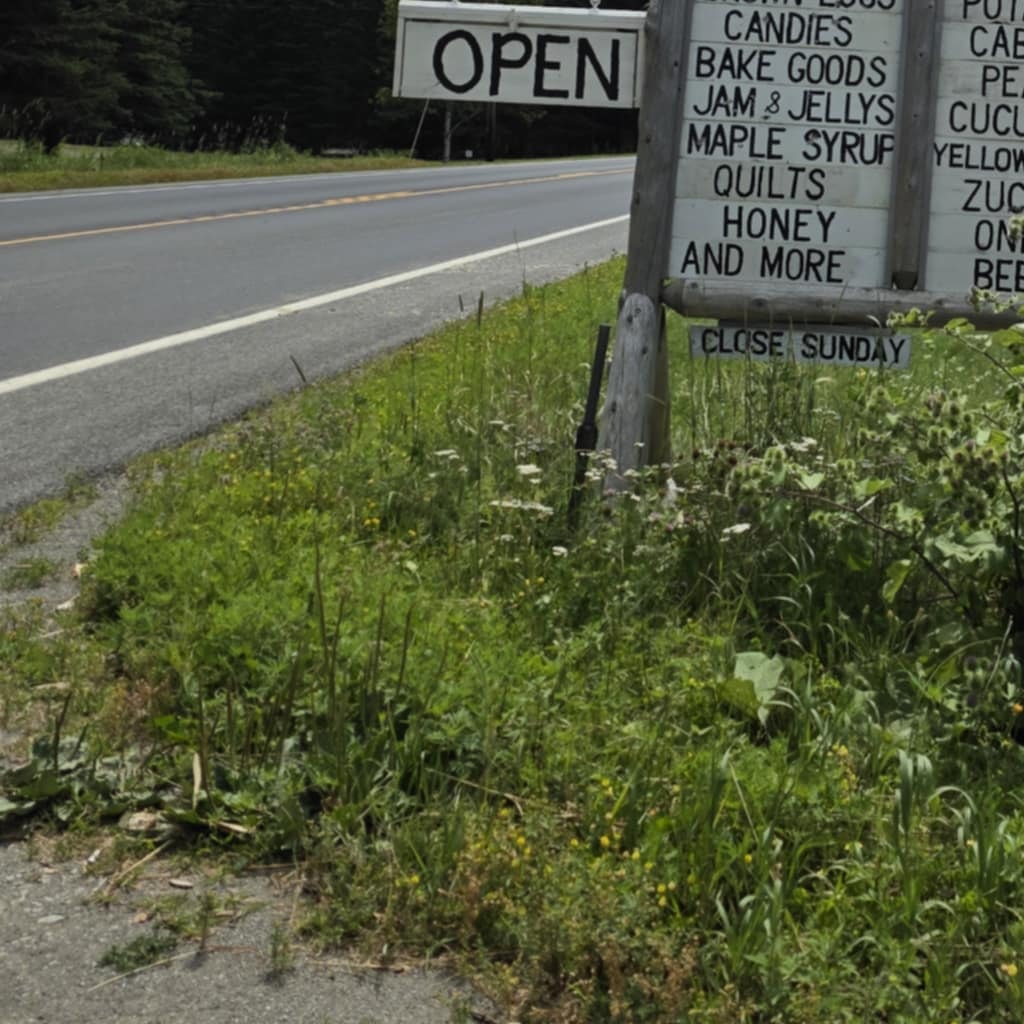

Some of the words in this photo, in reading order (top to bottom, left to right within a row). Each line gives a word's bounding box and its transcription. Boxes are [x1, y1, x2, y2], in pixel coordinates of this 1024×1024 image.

[724, 9, 853, 47] CANDIES
[433, 29, 620, 101] OPEN
[695, 46, 776, 81] BAKE
[787, 51, 887, 88] GOODS
[693, 85, 756, 118] JAM
[764, 91, 780, 114] &
[788, 90, 895, 126] JELLYS
[687, 123, 786, 160] MAPLE
[802, 129, 894, 165] SYRUP
[713, 164, 826, 201] QUILTS
[723, 205, 836, 243] HONEY
[681, 241, 744, 276] AND
[760, 245, 845, 283] MORE
[701, 329, 784, 356] CLOSE
[801, 333, 905, 363] SUNDAY
